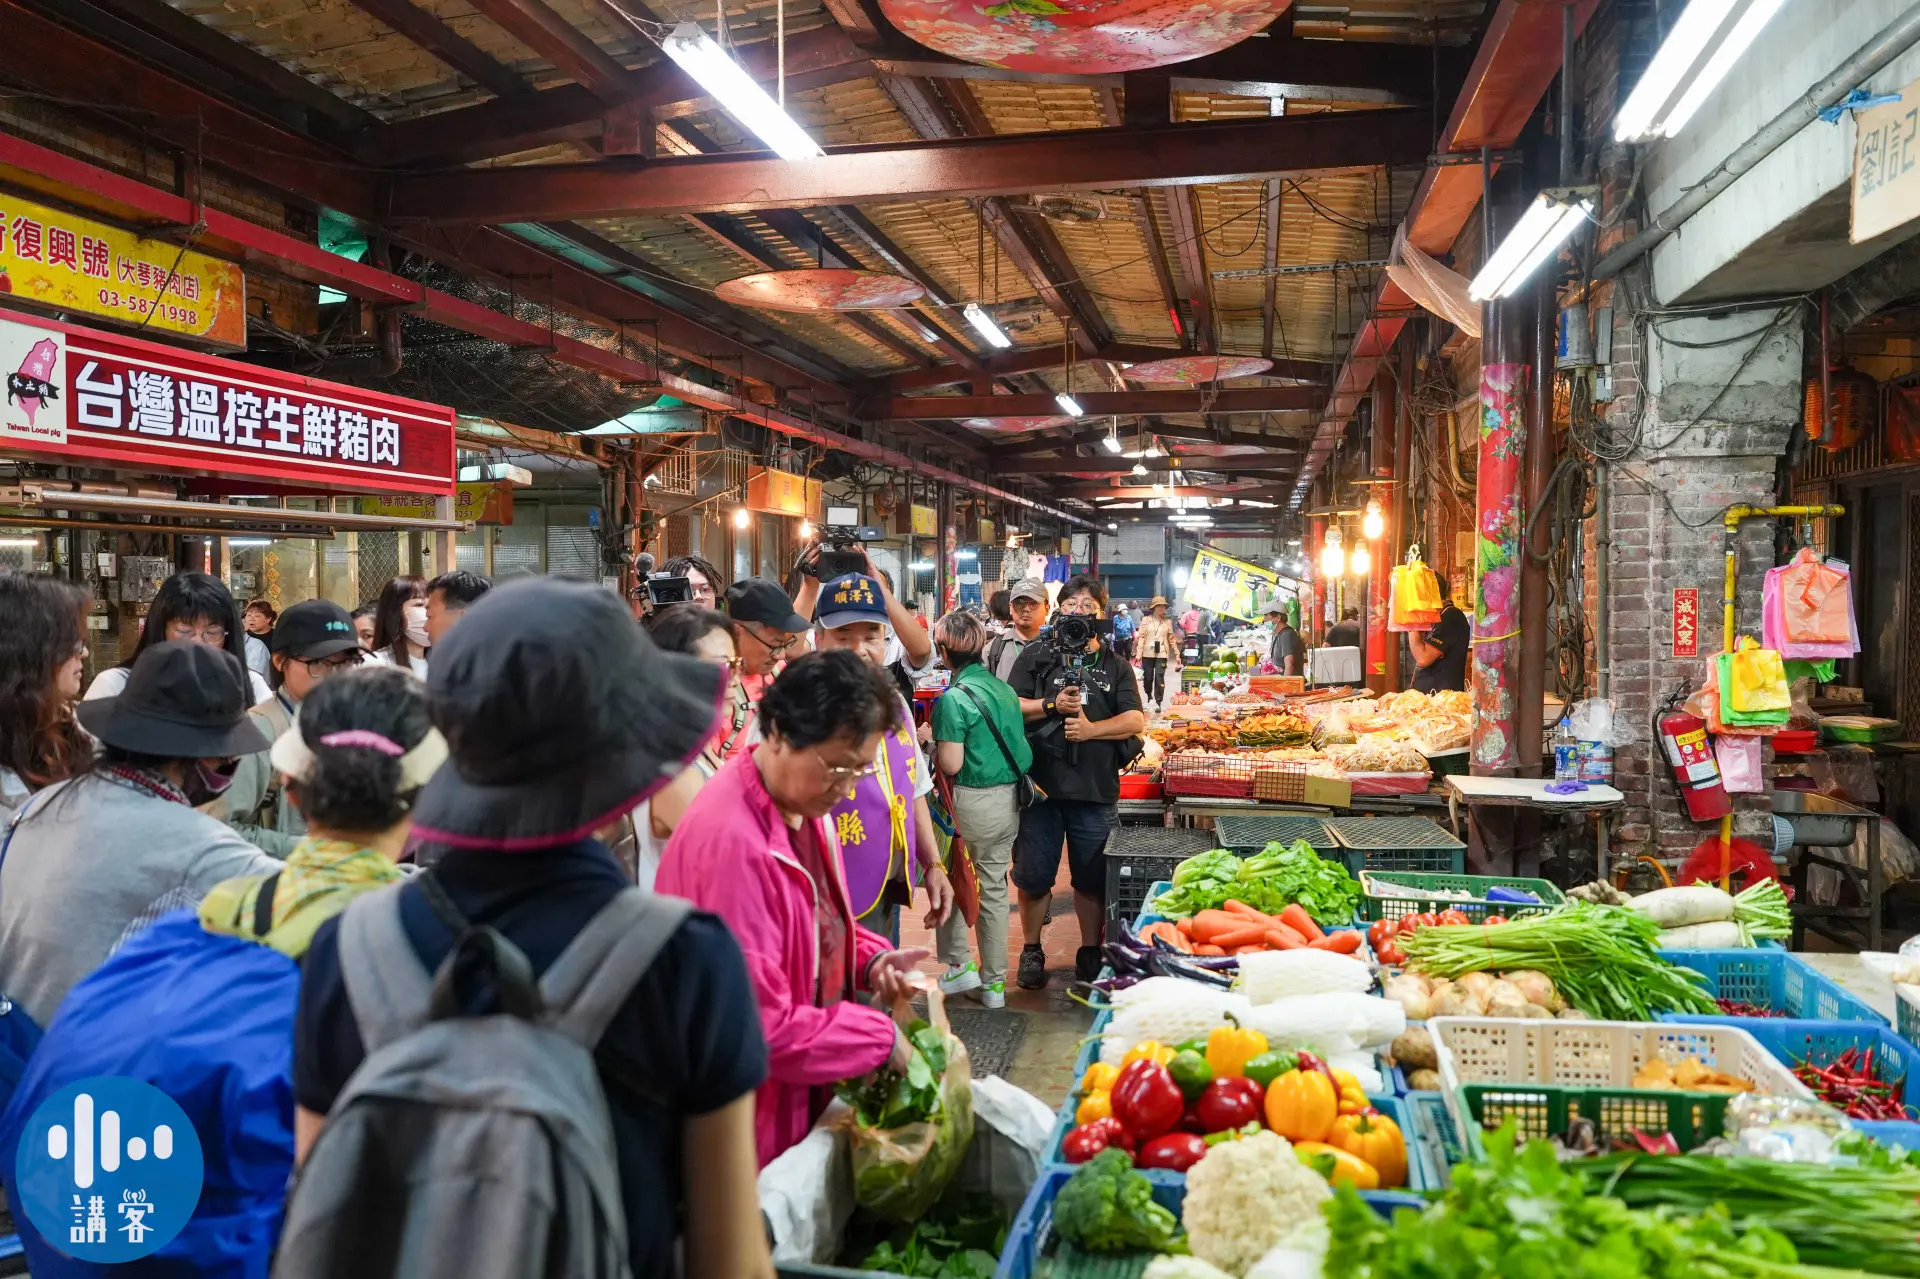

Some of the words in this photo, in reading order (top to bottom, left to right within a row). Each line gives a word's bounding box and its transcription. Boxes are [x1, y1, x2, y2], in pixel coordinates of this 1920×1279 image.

[1859, 106, 1919, 199] 劉記
[98, 288, 198, 326] 03-5871998
[7, 422, 30, 433] Taiwan
[31, 425, 49, 435] Local
[50, 427, 61, 438] pig
[75, 361, 400, 467] 台灣溫控生鮮豬肉
[1676, 598, 1696, 647] 滅火器
